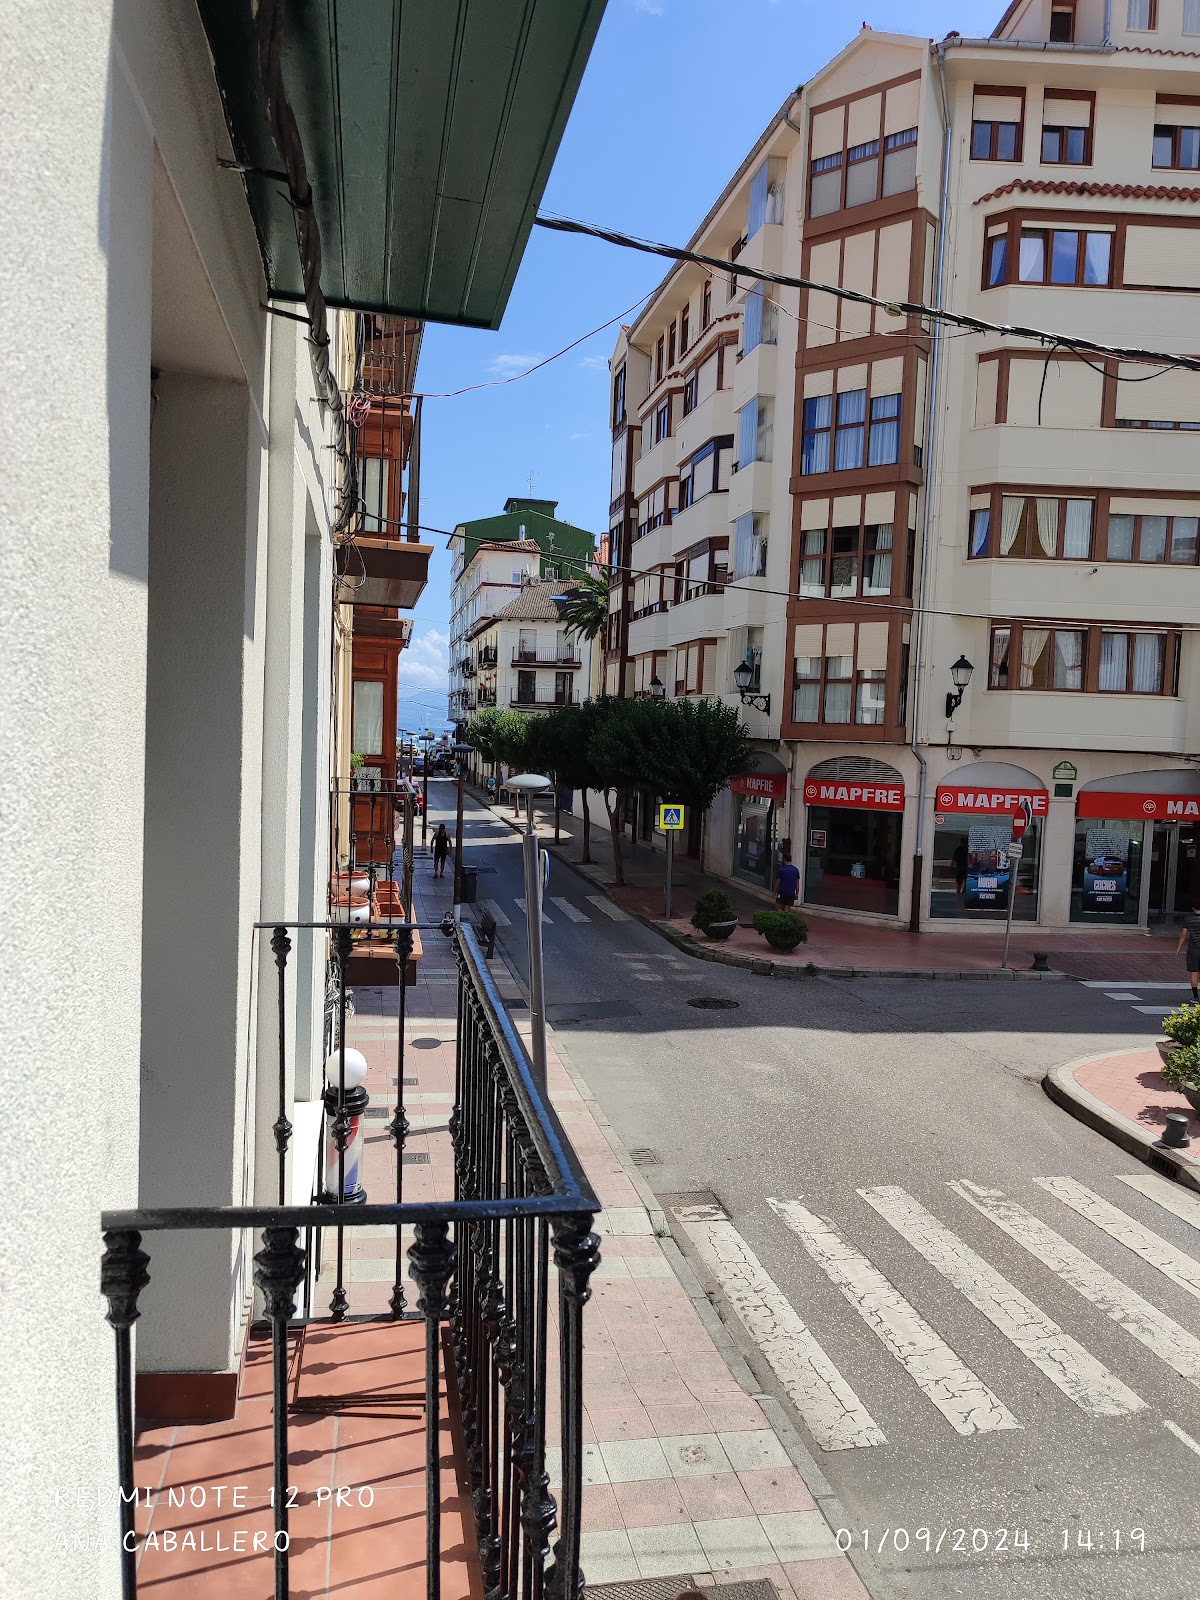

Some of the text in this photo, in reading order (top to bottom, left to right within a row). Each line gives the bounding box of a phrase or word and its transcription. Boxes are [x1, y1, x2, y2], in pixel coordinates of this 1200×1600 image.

[746, 777, 774, 792] MAPFRE
[820, 785, 901, 805] MAPFRE
[1166, 800, 1200, 815] MA
[977, 876, 998, 889] HOGAR
[1093, 879, 1117, 891] COCHES
